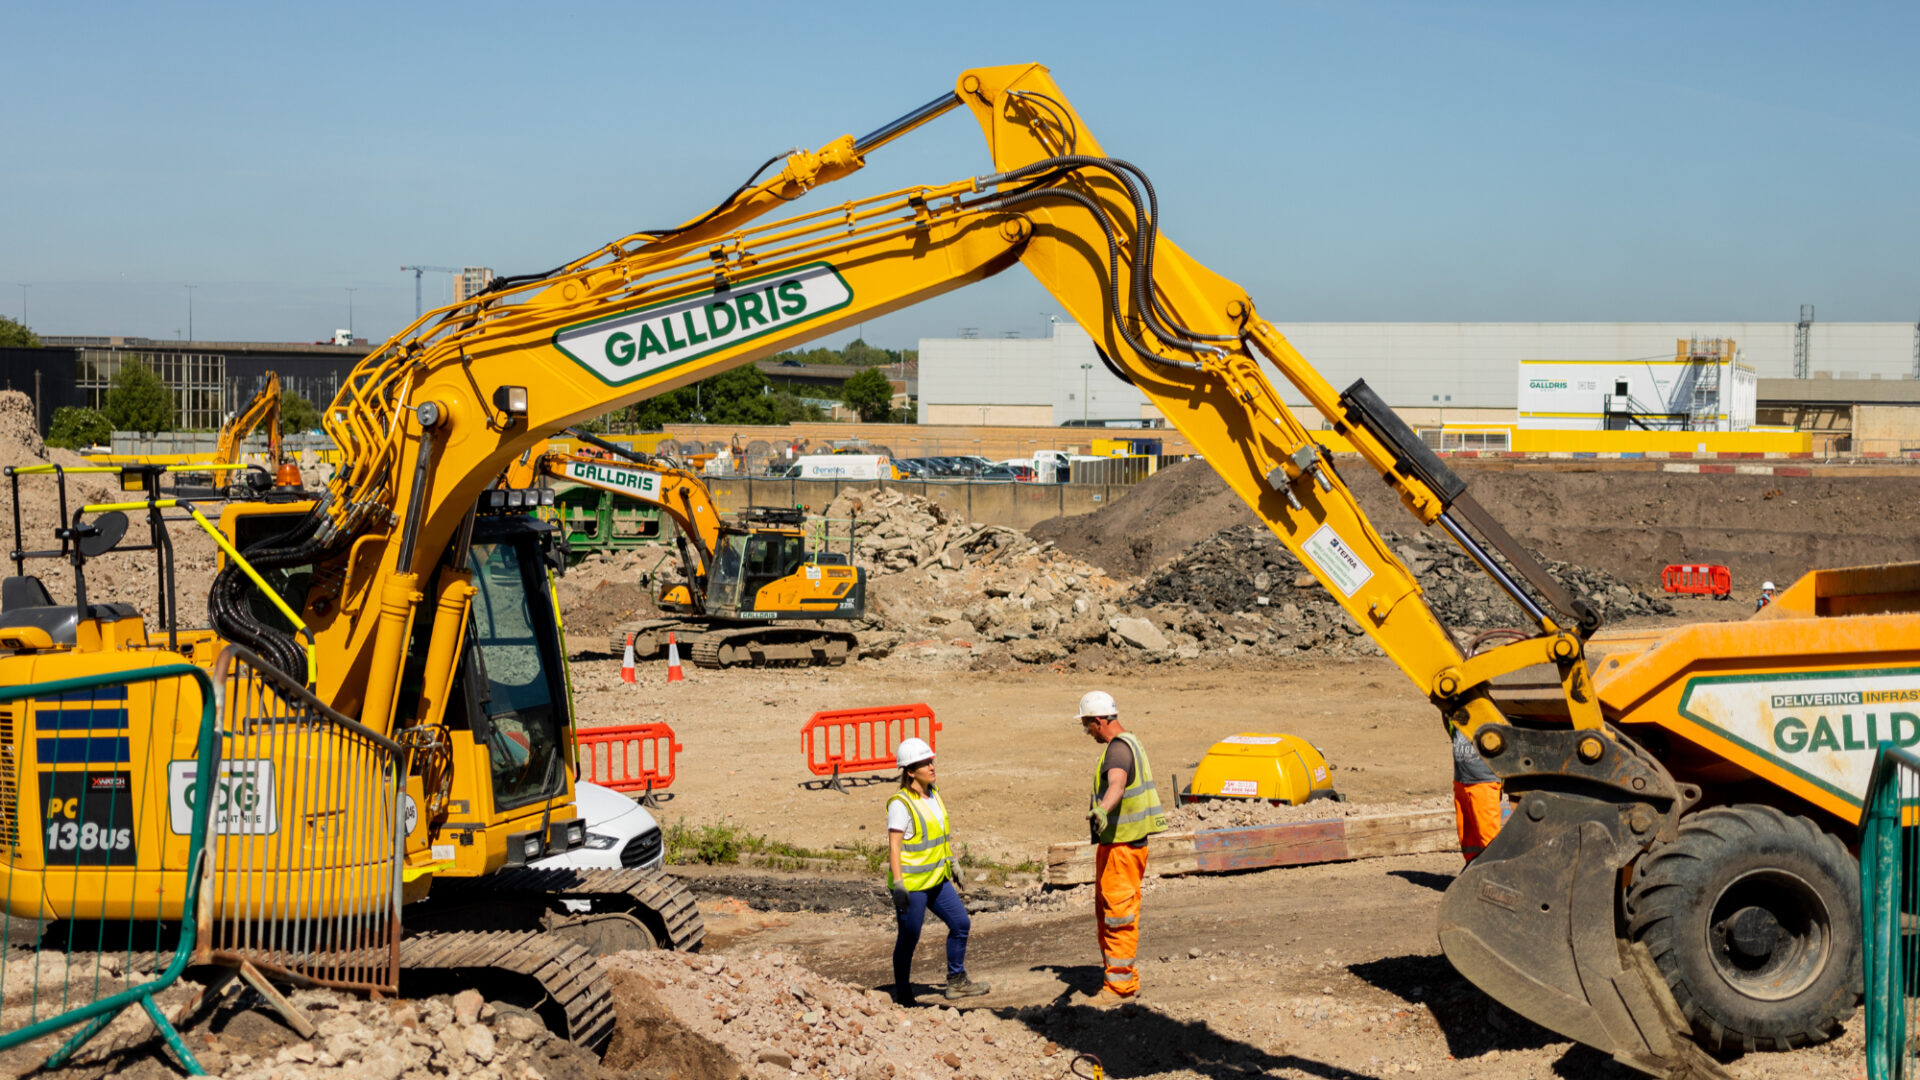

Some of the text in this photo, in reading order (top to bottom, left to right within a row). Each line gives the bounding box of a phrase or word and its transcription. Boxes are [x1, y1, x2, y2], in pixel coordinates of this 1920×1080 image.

[605, 279, 807, 366] GALLDRIS
[574, 463, 653, 491] GALLDRIS
[1337, 545, 1358, 569] TEFRA
[1774, 693, 1860, 707] DELIVERING
[92, 777, 125, 786] XWATCH
[47, 797, 78, 819] PC
